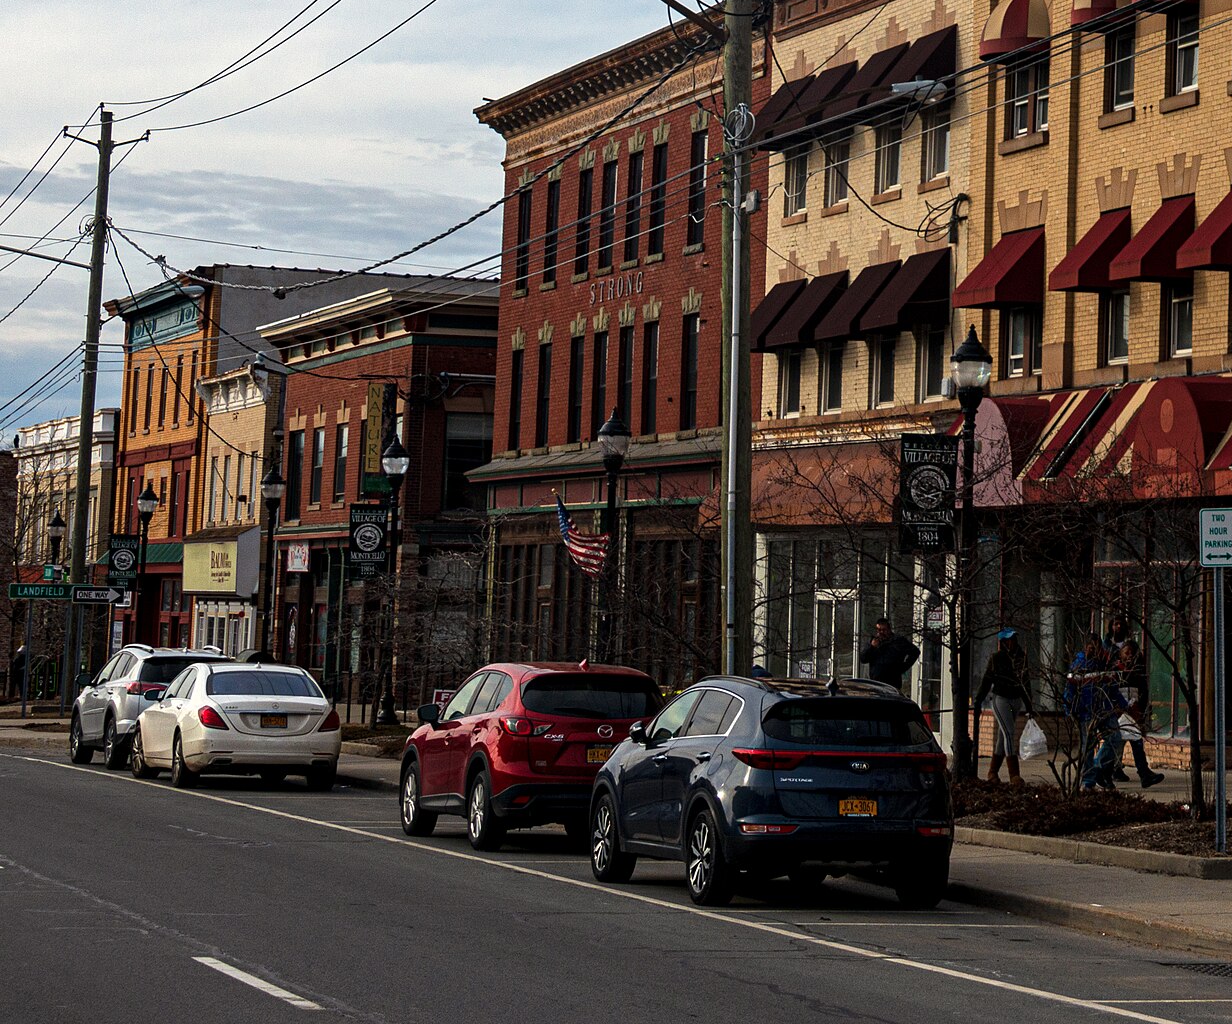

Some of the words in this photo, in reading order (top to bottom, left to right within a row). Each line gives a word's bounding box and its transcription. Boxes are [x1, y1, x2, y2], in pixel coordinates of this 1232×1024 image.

[590, 271, 643, 305] STRONG
[367, 387, 381, 469] NATURE
[904, 442, 957, 450] WELCOME
[904, 451, 940, 464] VILLAGE
[942, 453, 956, 465] OF
[377, 515, 386, 523] OF
[1212, 514, 1225, 522] TWO
[1209, 527, 1228, 535] HOUR
[918, 531, 938, 542] 1804
[1205, 540, 1232, 548] PARKING
[350, 551, 385, 560] MONTICELLO
[17, 586, 64, 596] LANDFIELD
[95, 591, 109, 599] WAY
